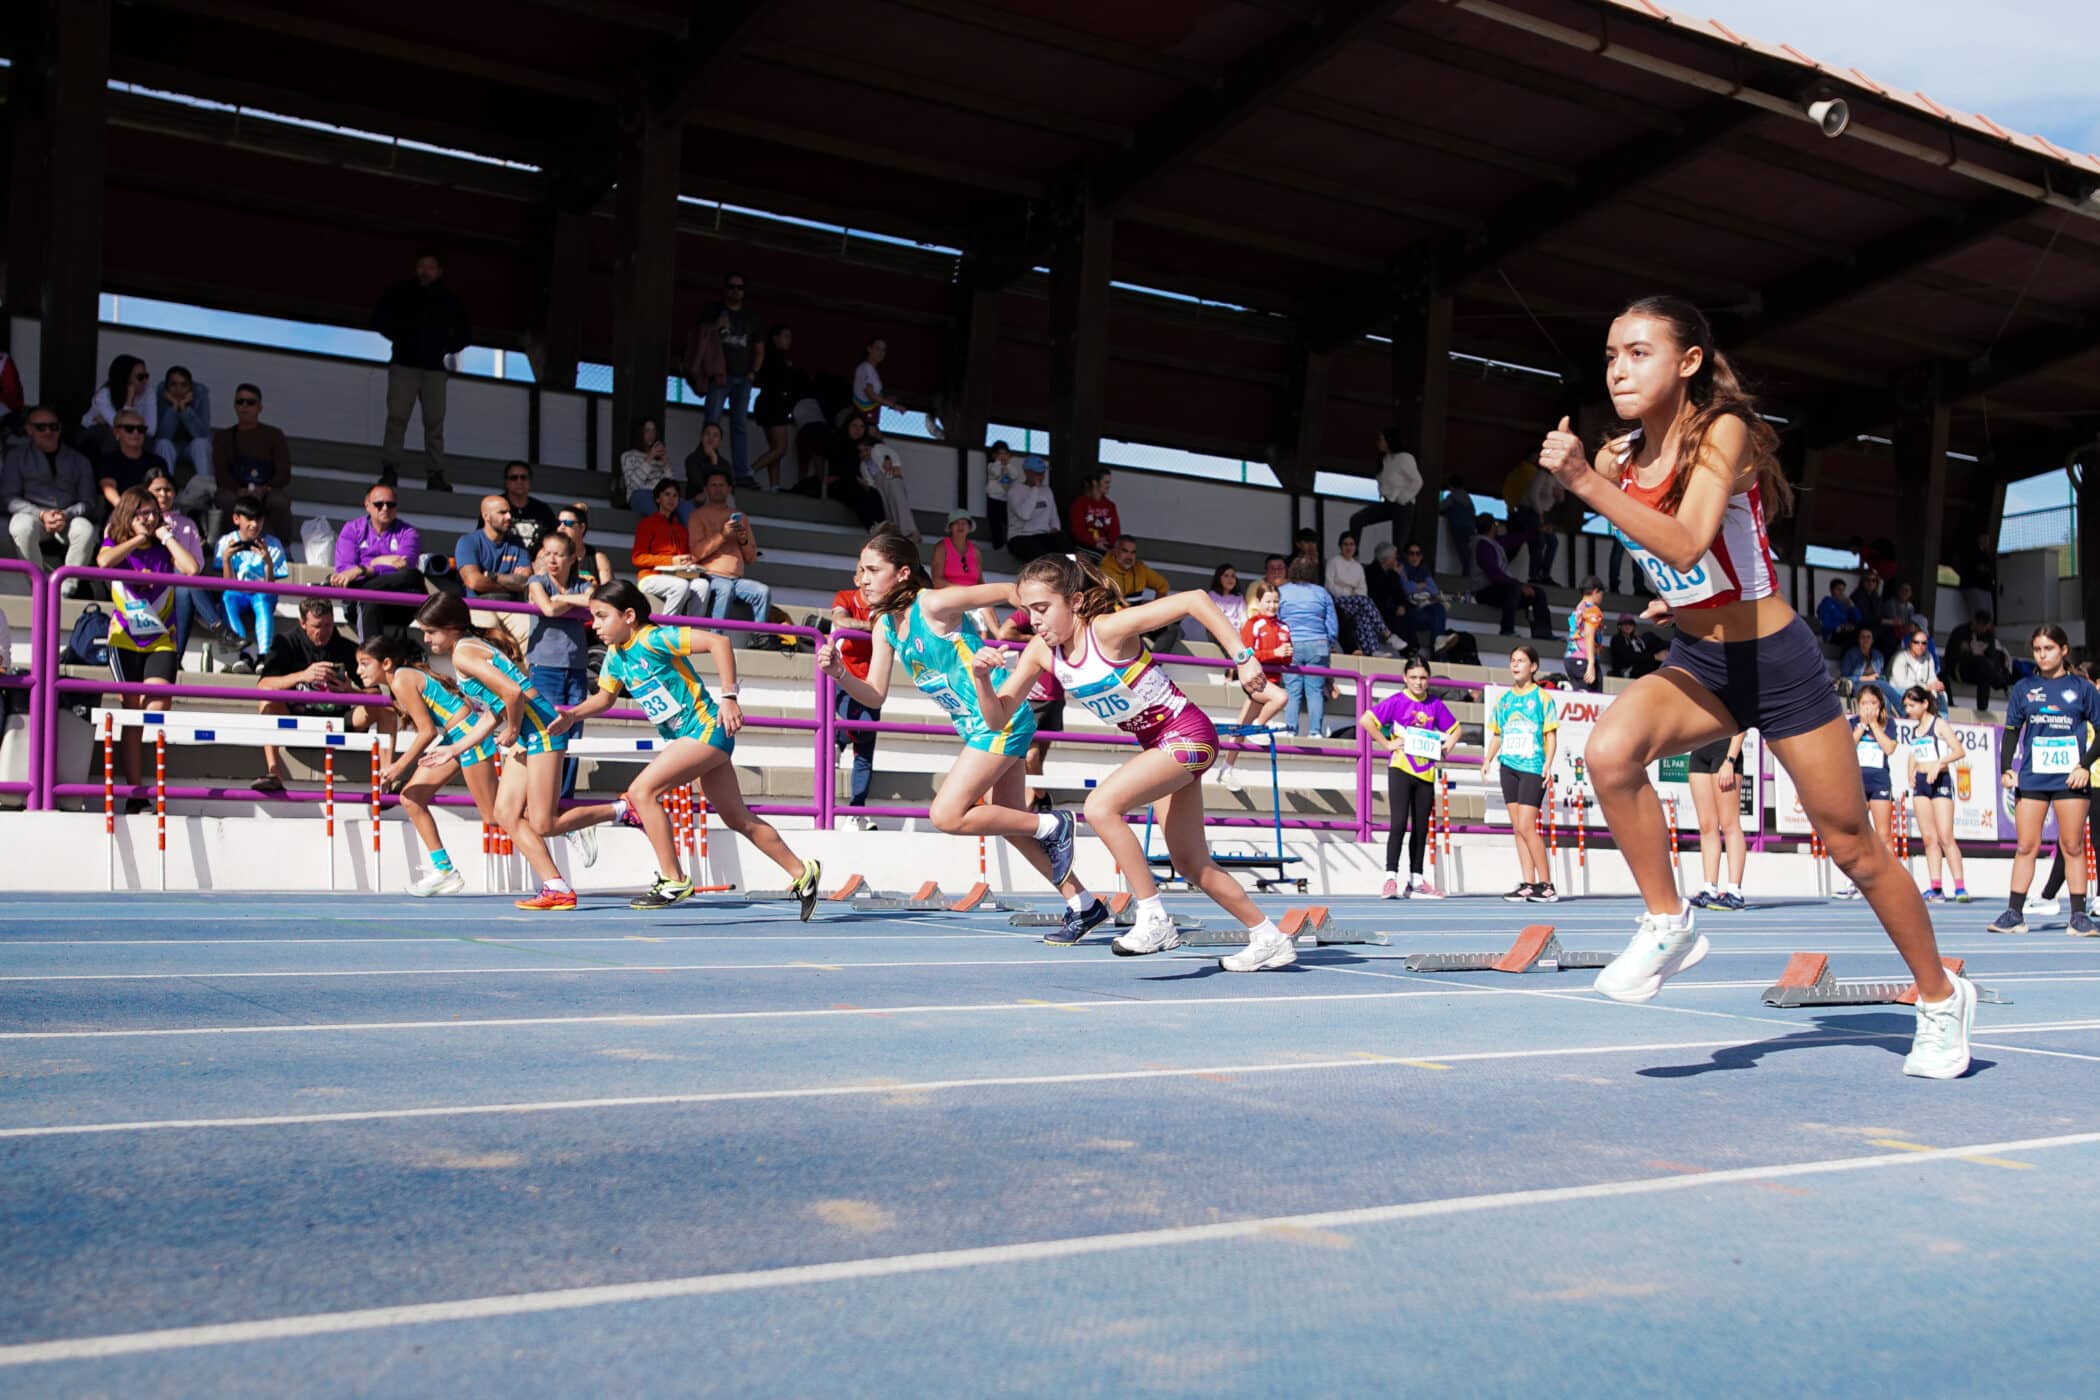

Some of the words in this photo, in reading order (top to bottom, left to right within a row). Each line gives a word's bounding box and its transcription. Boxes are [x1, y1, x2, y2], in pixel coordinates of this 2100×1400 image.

[640, 695, 668, 718] 33
[931, 693, 960, 709] 36
[1559, 702, 1599, 722] ADN
[2042, 751, 2069, 766] 248
